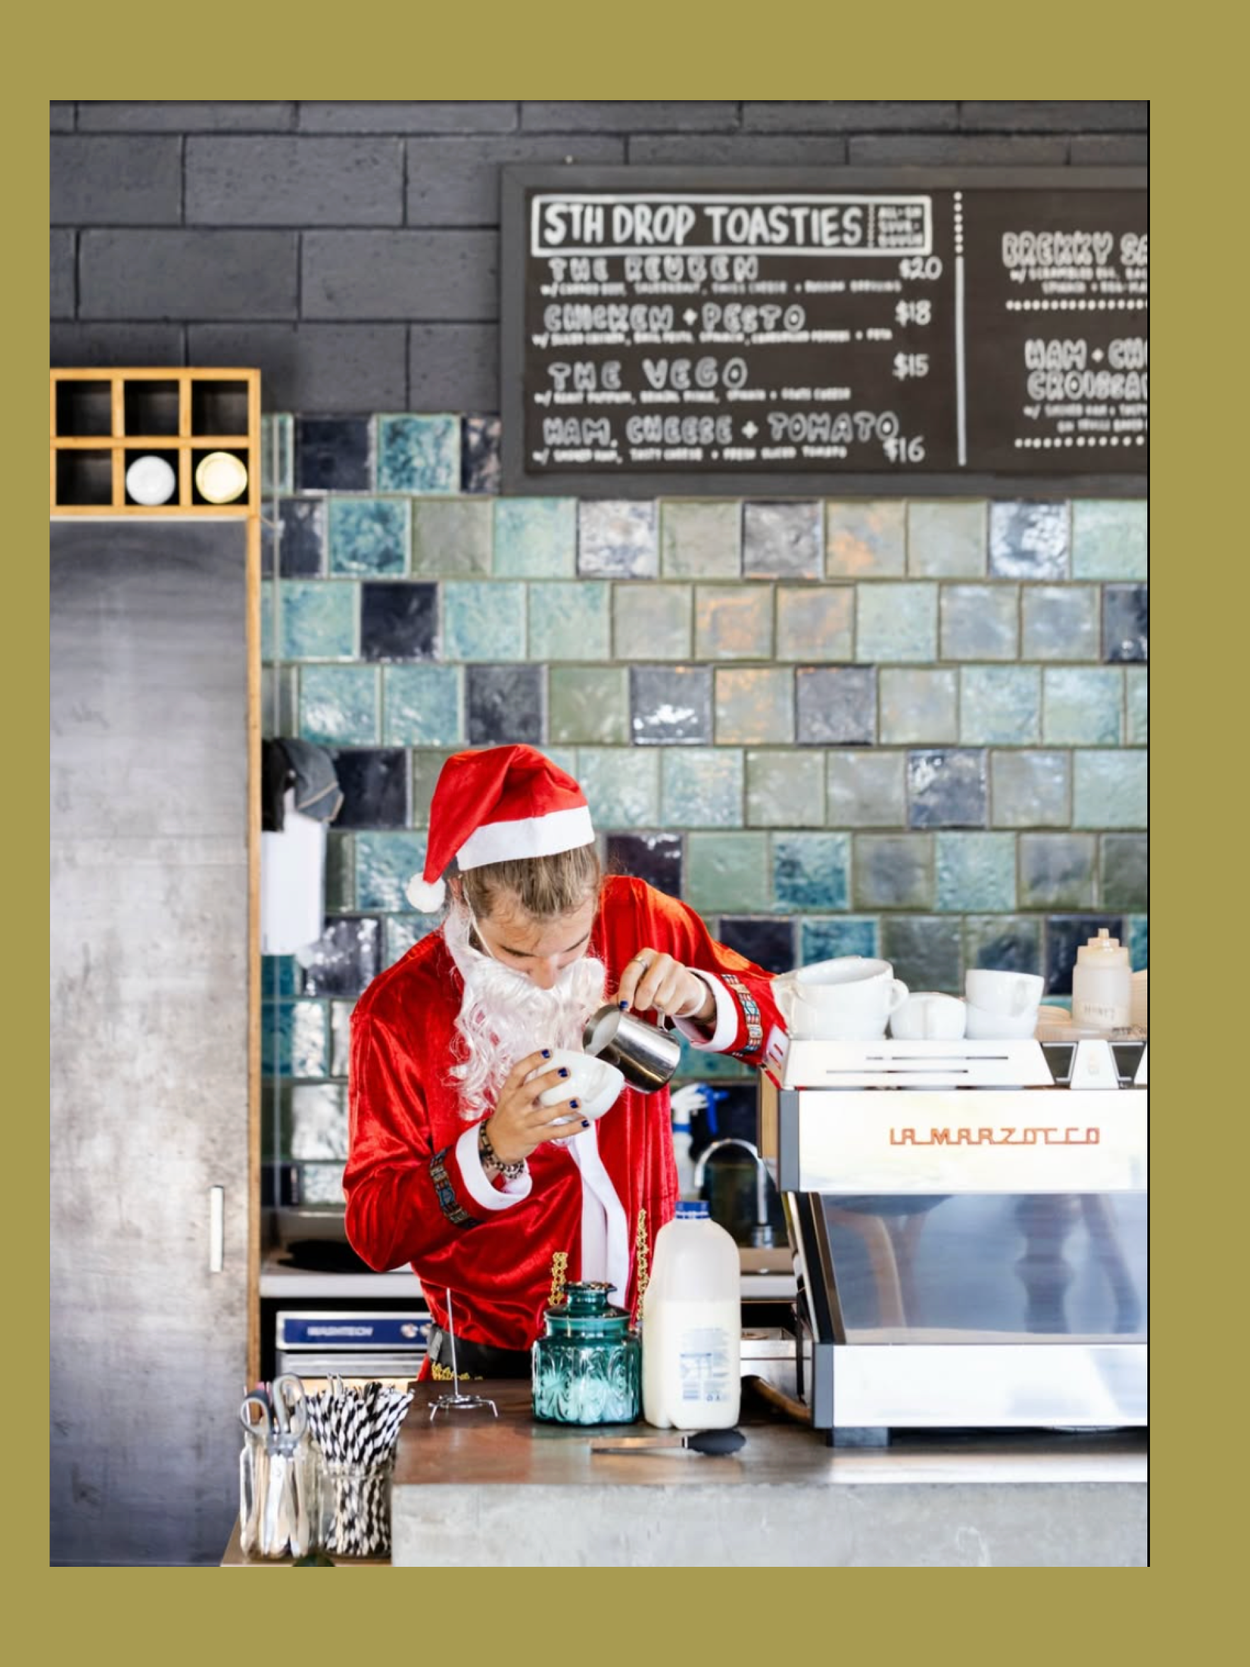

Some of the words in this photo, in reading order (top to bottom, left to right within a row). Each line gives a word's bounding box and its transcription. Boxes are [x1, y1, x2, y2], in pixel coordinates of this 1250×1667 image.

[543, 203, 604, 245] STH
[613, 203, 696, 246] DROP
[703, 204, 863, 246] TOASTIES
[1002, 231, 1113, 268] BREKKY
[548, 256, 609, 282] THE
[624, 254, 759, 283] REUBEN
[899, 255, 943, 281] $20
[543, 303, 674, 332] CHICKEN
[702, 301, 805, 333] PESTO
[895, 299, 931, 327] $18
[892, 351, 930, 381] $15
[1025, 338, 1087, 370] HAM
[1108, 337, 1147, 369] CH
[547, 360, 622, 392] THE
[642, 356, 748, 390] VEGO
[625, 414, 733, 445] CHEESE
[741, 420, 759, 439] +
[767, 411, 899, 443] TOMATO
[883, 435, 925, 463] $16
[890, 1128, 916, 1145] LA
